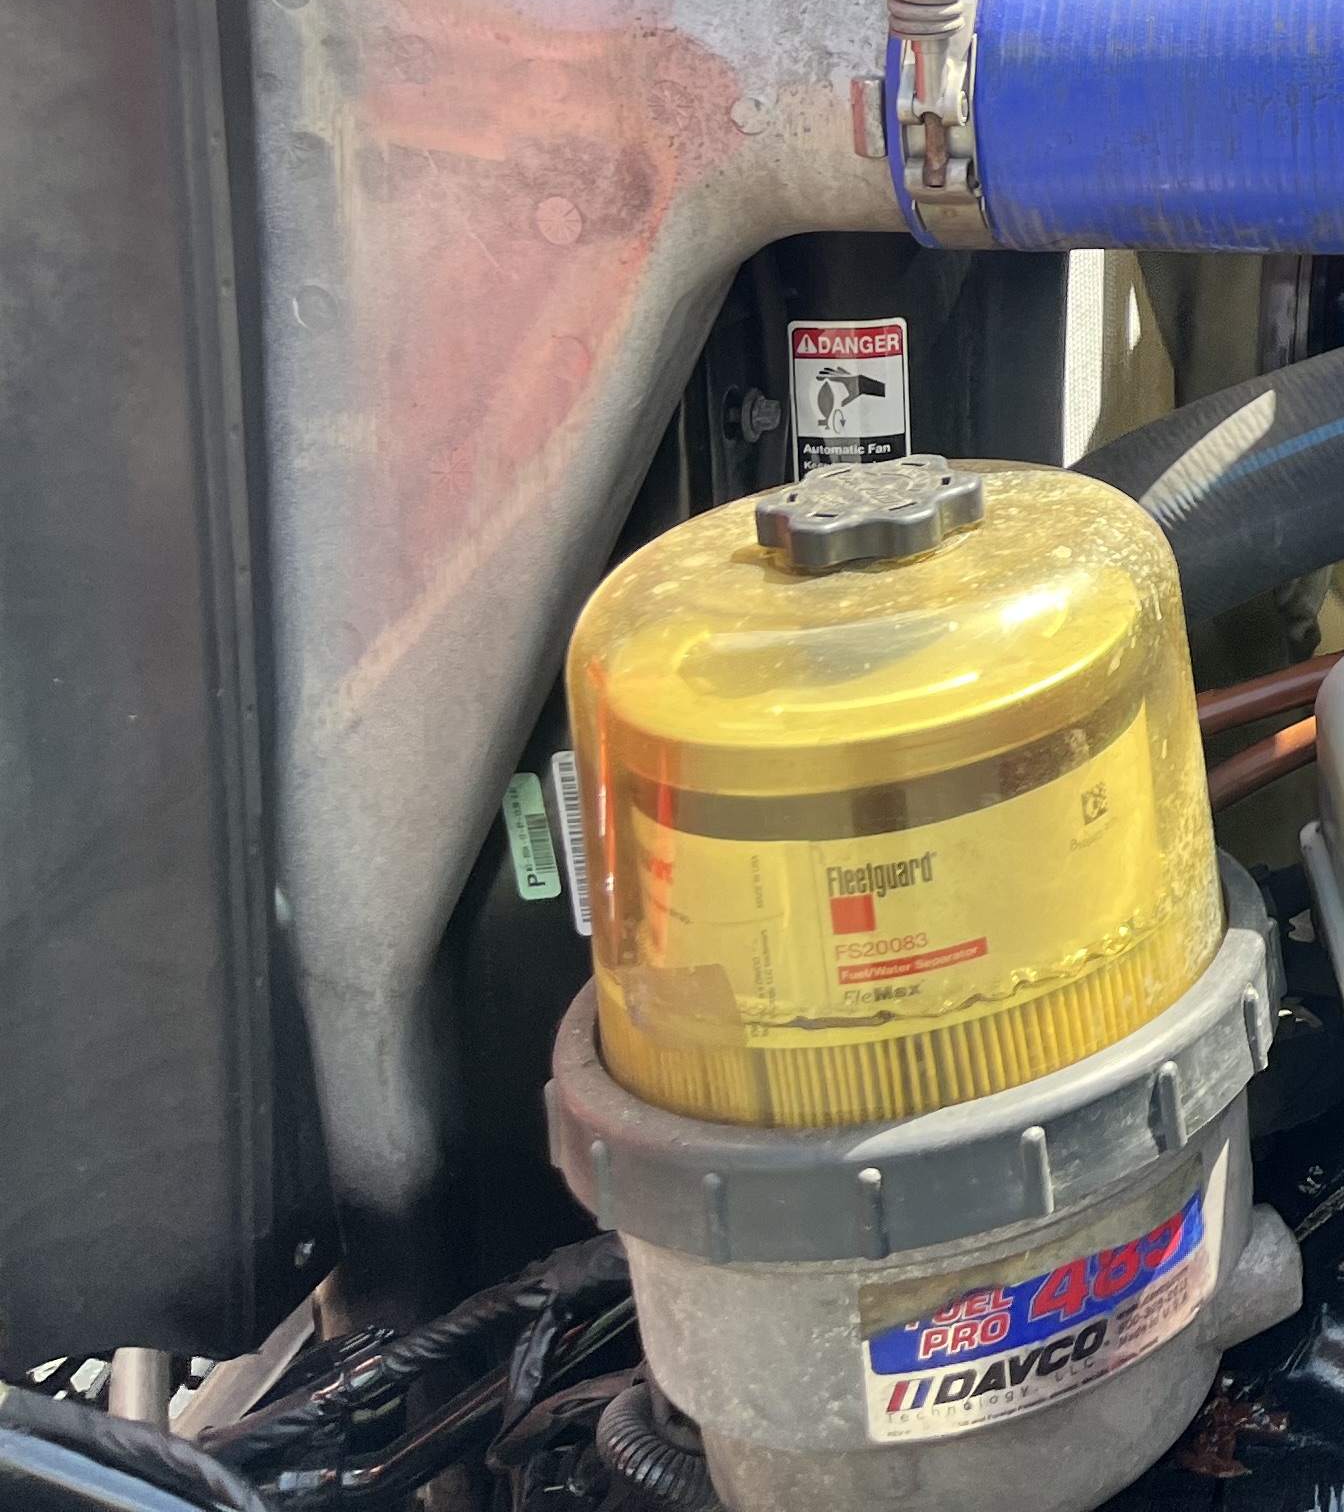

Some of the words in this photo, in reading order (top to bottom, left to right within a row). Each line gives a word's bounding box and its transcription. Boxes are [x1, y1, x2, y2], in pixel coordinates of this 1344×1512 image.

[818, 333, 900, 355] DANGER
[803, 443, 865, 455] Automatic
[868, 442, 891, 454] Fan
[826, 851, 934, 898] Fleetguard
[834, 932, 929, 961] FS20083
[840, 962, 912, 983] Fuel/Water
[914, 944, 979, 970] Separator
[905, 1285, 1014, 1332] UEL
[918, 1312, 1011, 1361] PRO
